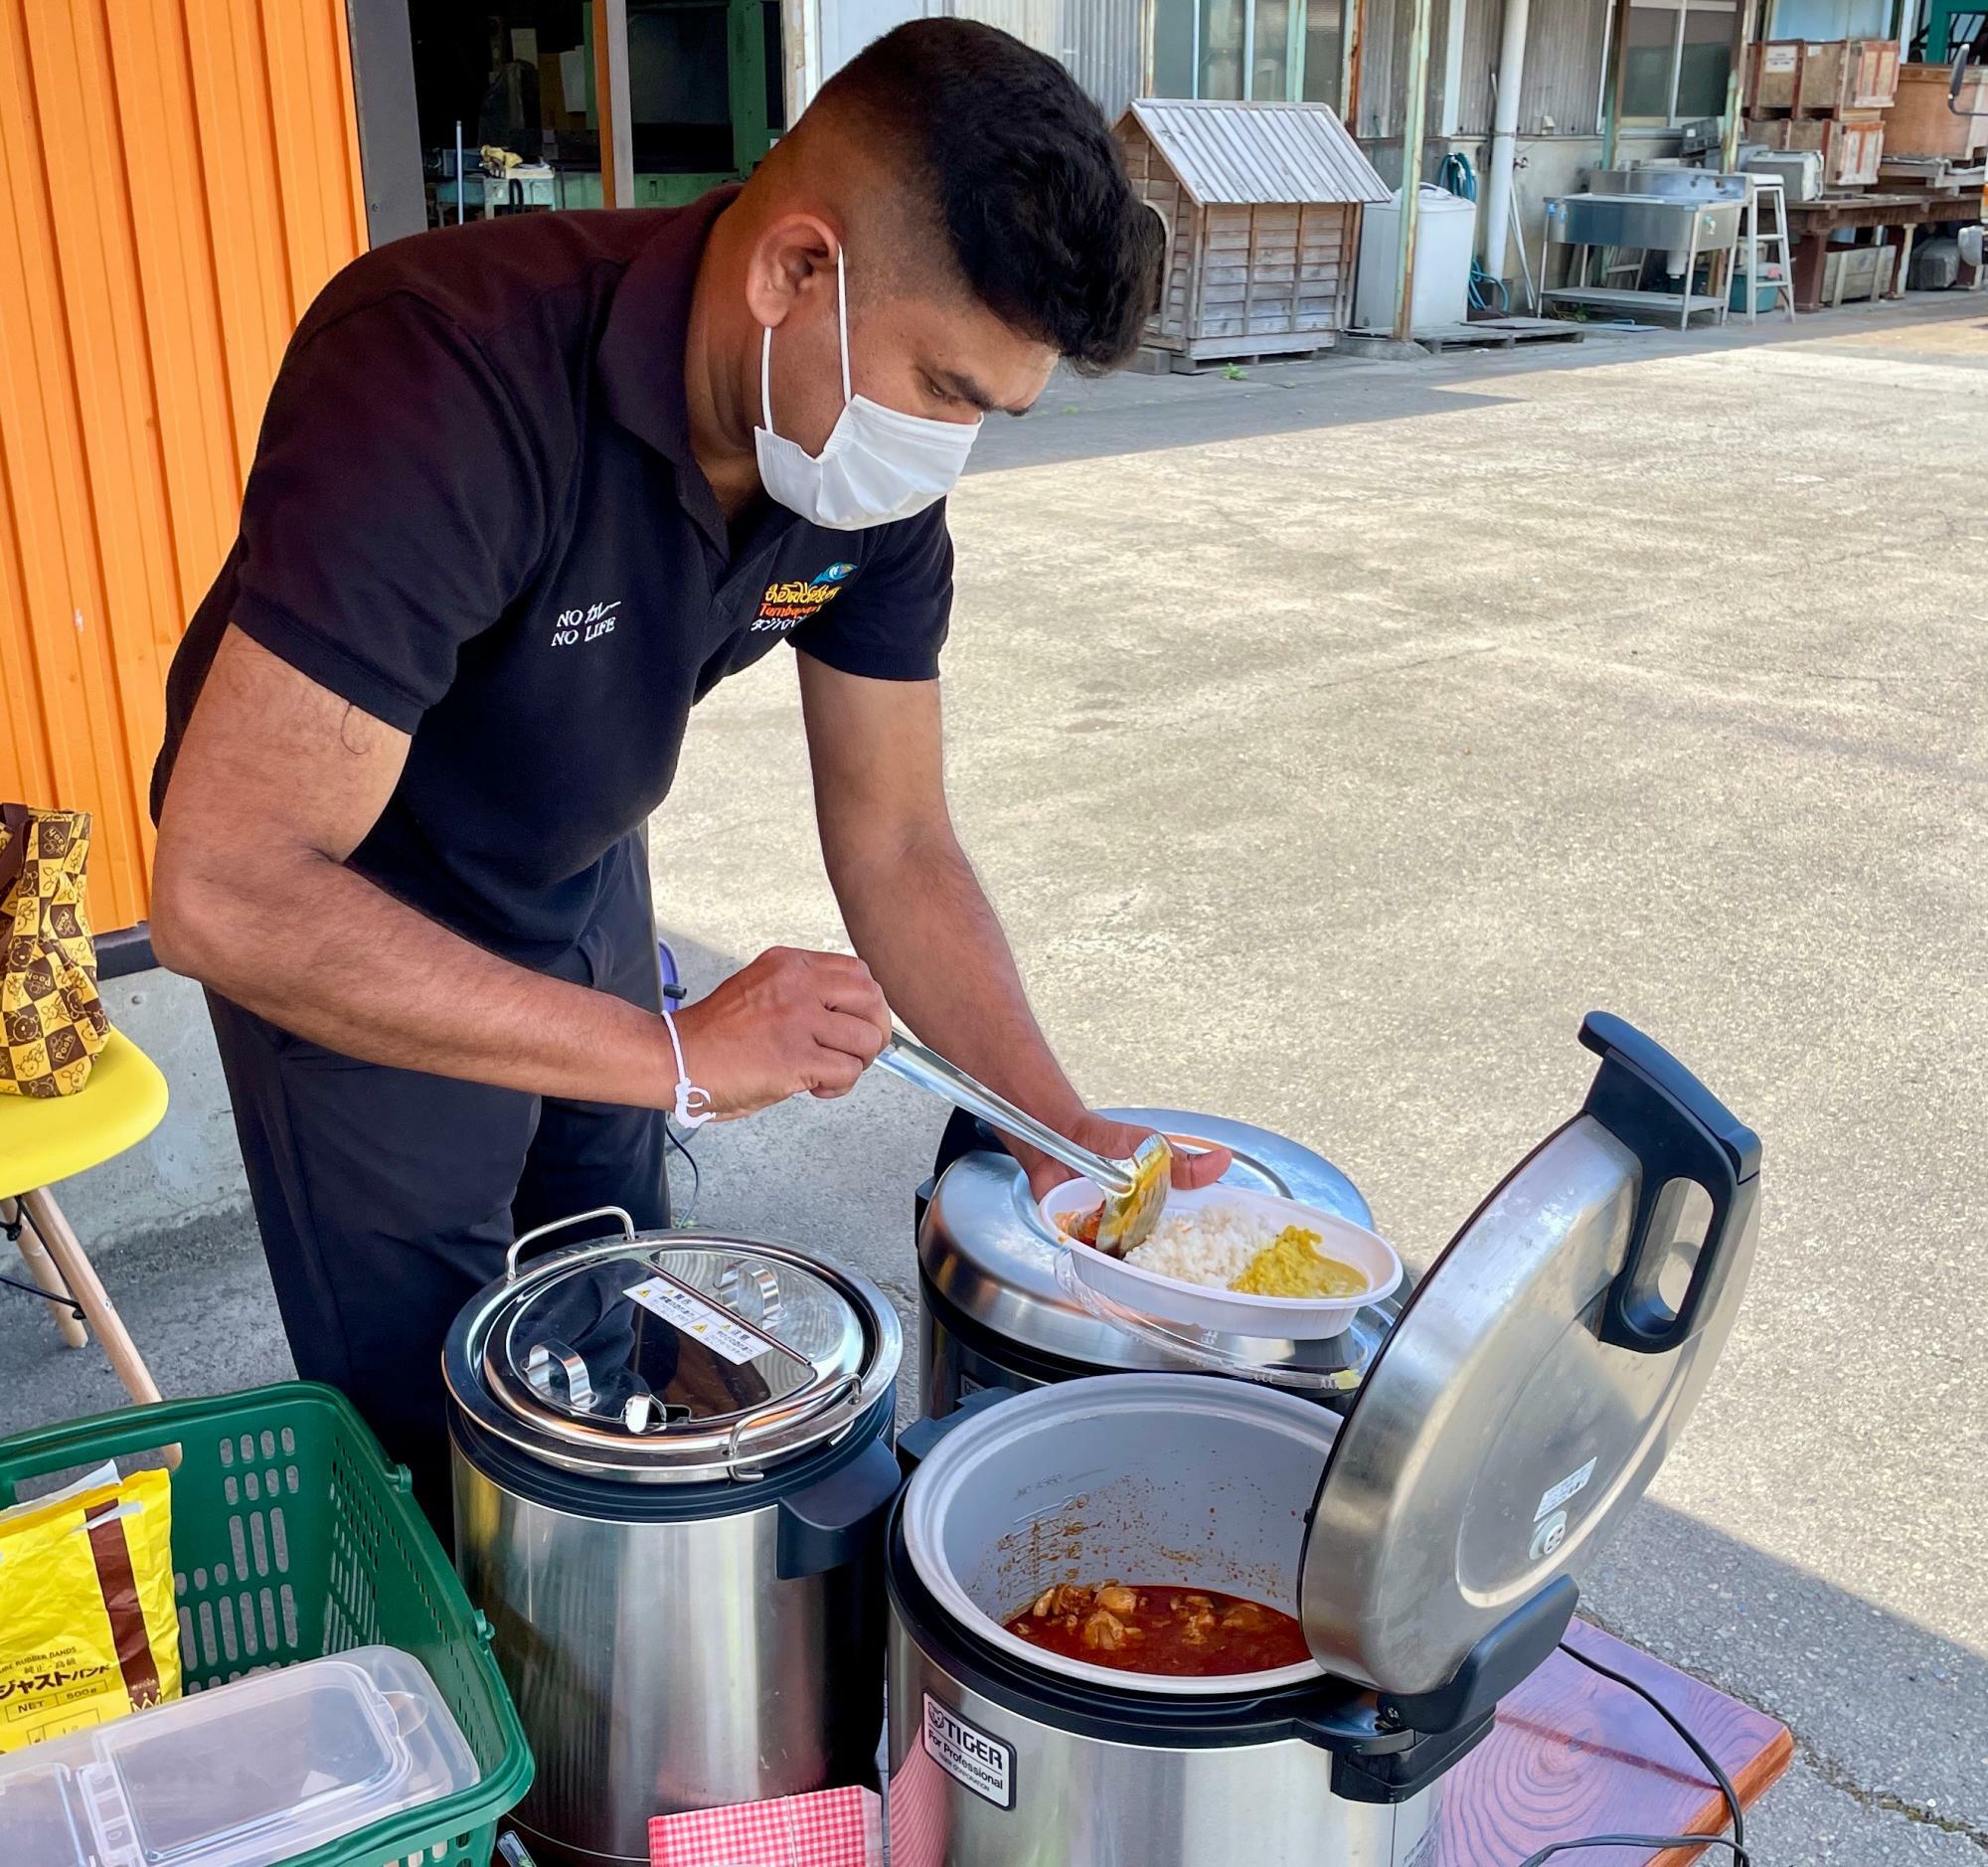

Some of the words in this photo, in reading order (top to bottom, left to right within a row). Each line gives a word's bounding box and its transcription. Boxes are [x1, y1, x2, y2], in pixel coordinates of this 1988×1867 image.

[557, 609, 583, 627] NO
[551, 629, 579, 647] NO
[584, 616, 616, 642] LIFE
[27, 970, 51, 987] Pooh
[55, 1035, 74, 1060] Pooh
[1063, 1493, 1090, 1511] 20
[15, 1653, 48, 1667] RUBBER
[50, 1645, 78, 1659] BANDS
[18, 1700, 45, 1714] NET
[944, 1717, 1003, 1771] TIGER
[928, 1729, 942, 1748] For
[943, 1743, 1003, 1789] Professional
